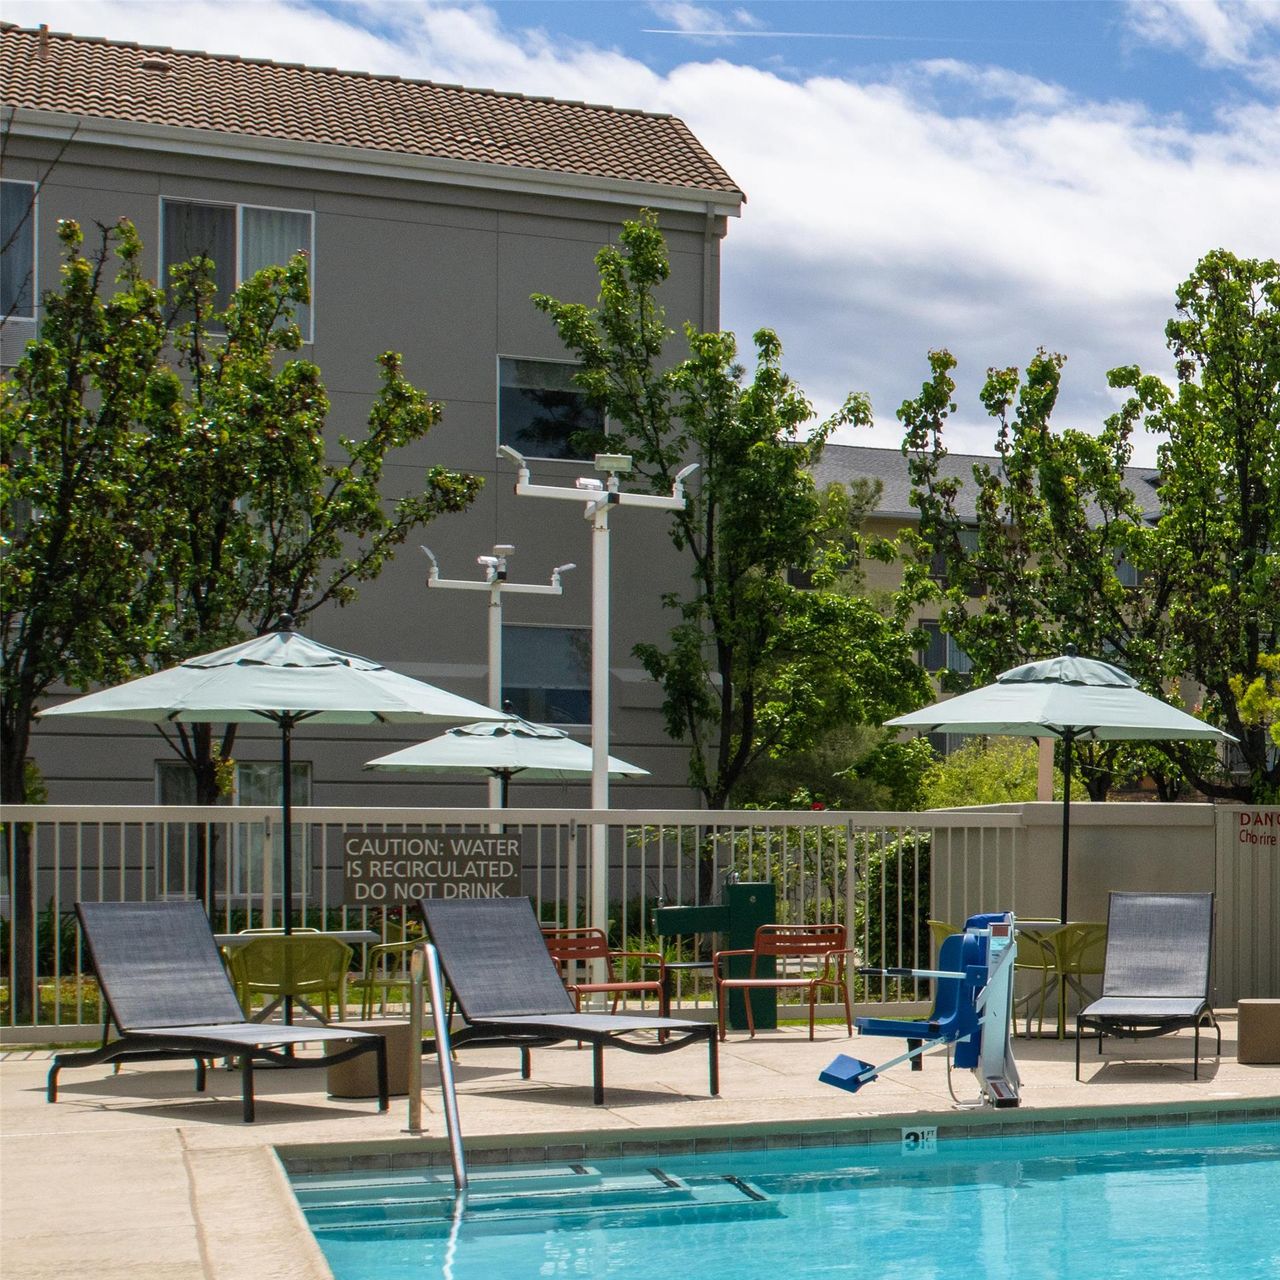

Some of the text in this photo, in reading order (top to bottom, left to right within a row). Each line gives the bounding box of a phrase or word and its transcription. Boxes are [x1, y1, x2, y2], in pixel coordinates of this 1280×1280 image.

[345, 838, 519, 856] CAUTION: WATER
[347, 861, 518, 878] IS RECIRCULATED.
[355, 882, 509, 900] DO NOT DRINK.
